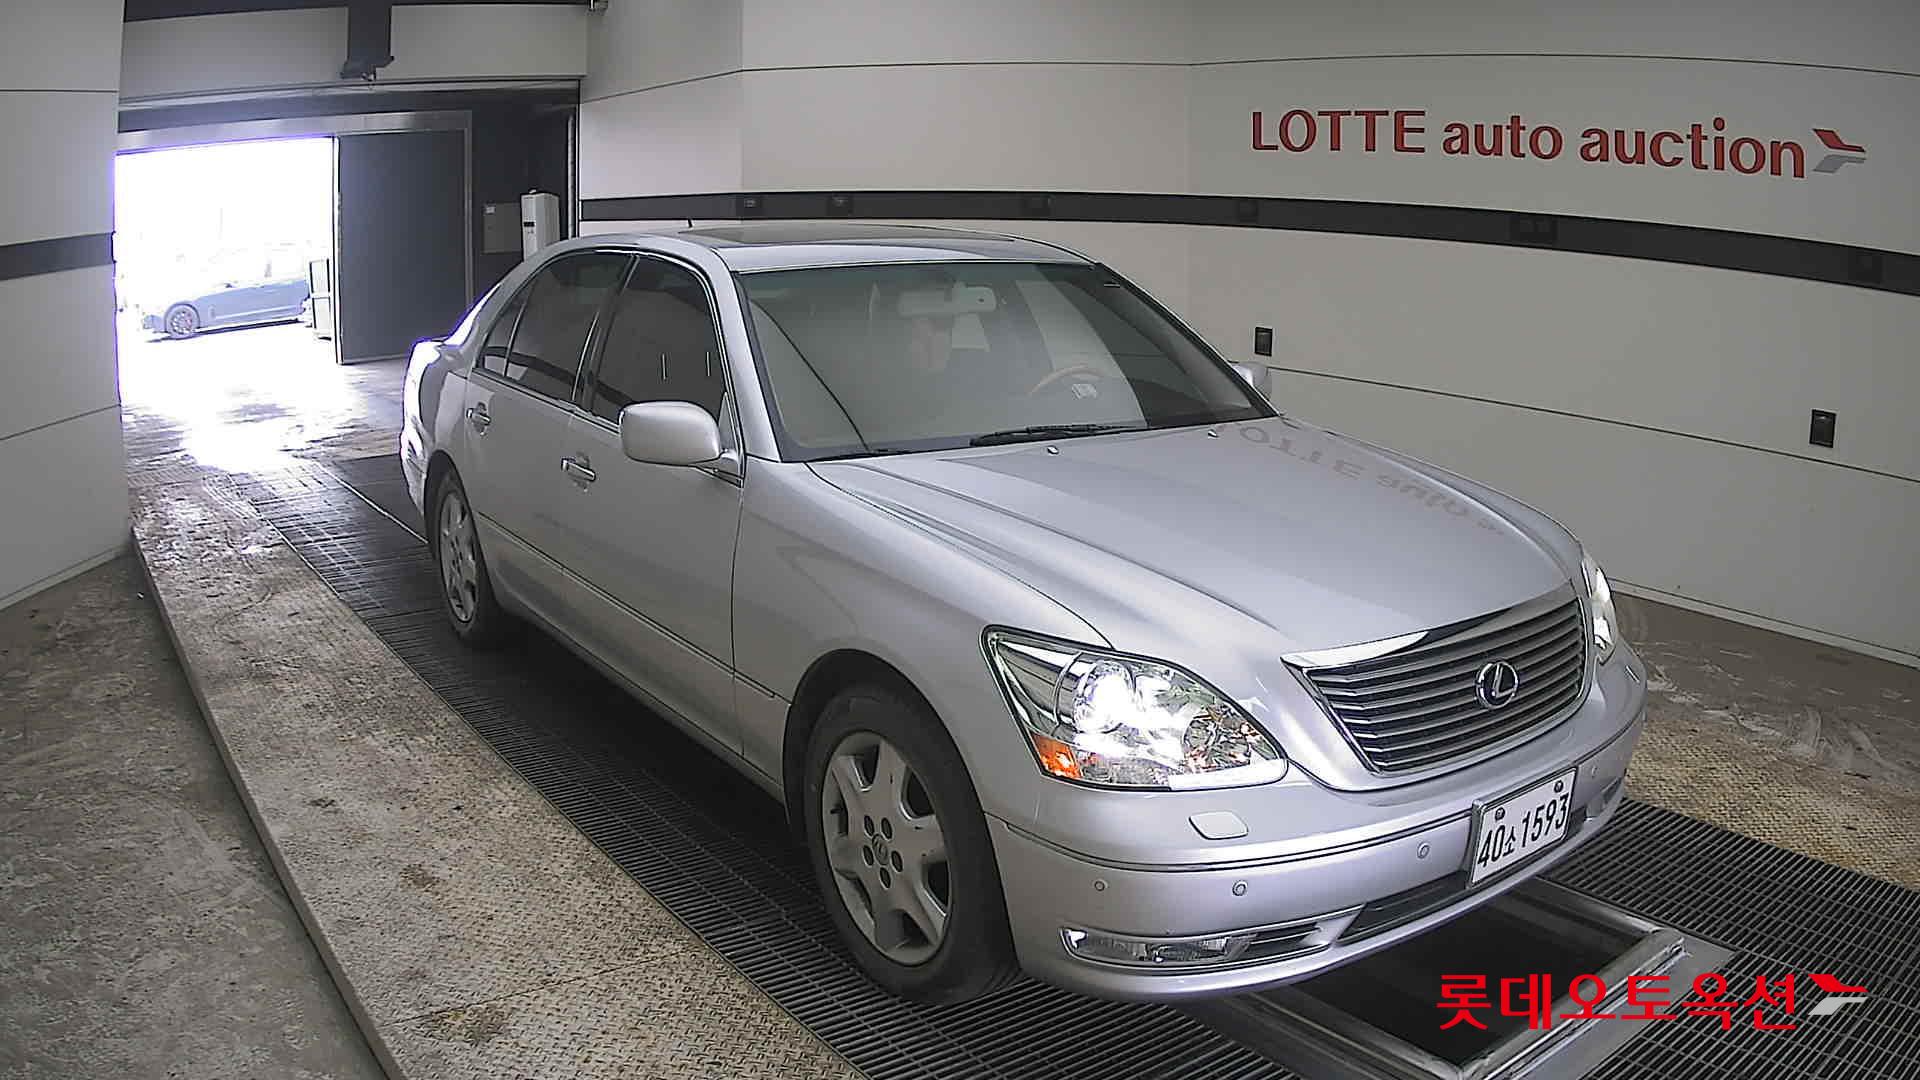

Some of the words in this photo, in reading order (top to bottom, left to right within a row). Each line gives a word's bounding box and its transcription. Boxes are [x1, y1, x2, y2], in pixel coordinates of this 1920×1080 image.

[1251, 109, 1426, 153] LOTTE
[1442, 114, 1563, 160] auto
[1579, 116, 1805, 179] auction
[1477, 824, 1517, 868] 40소
[1521, 791, 1570, 848] 1593
